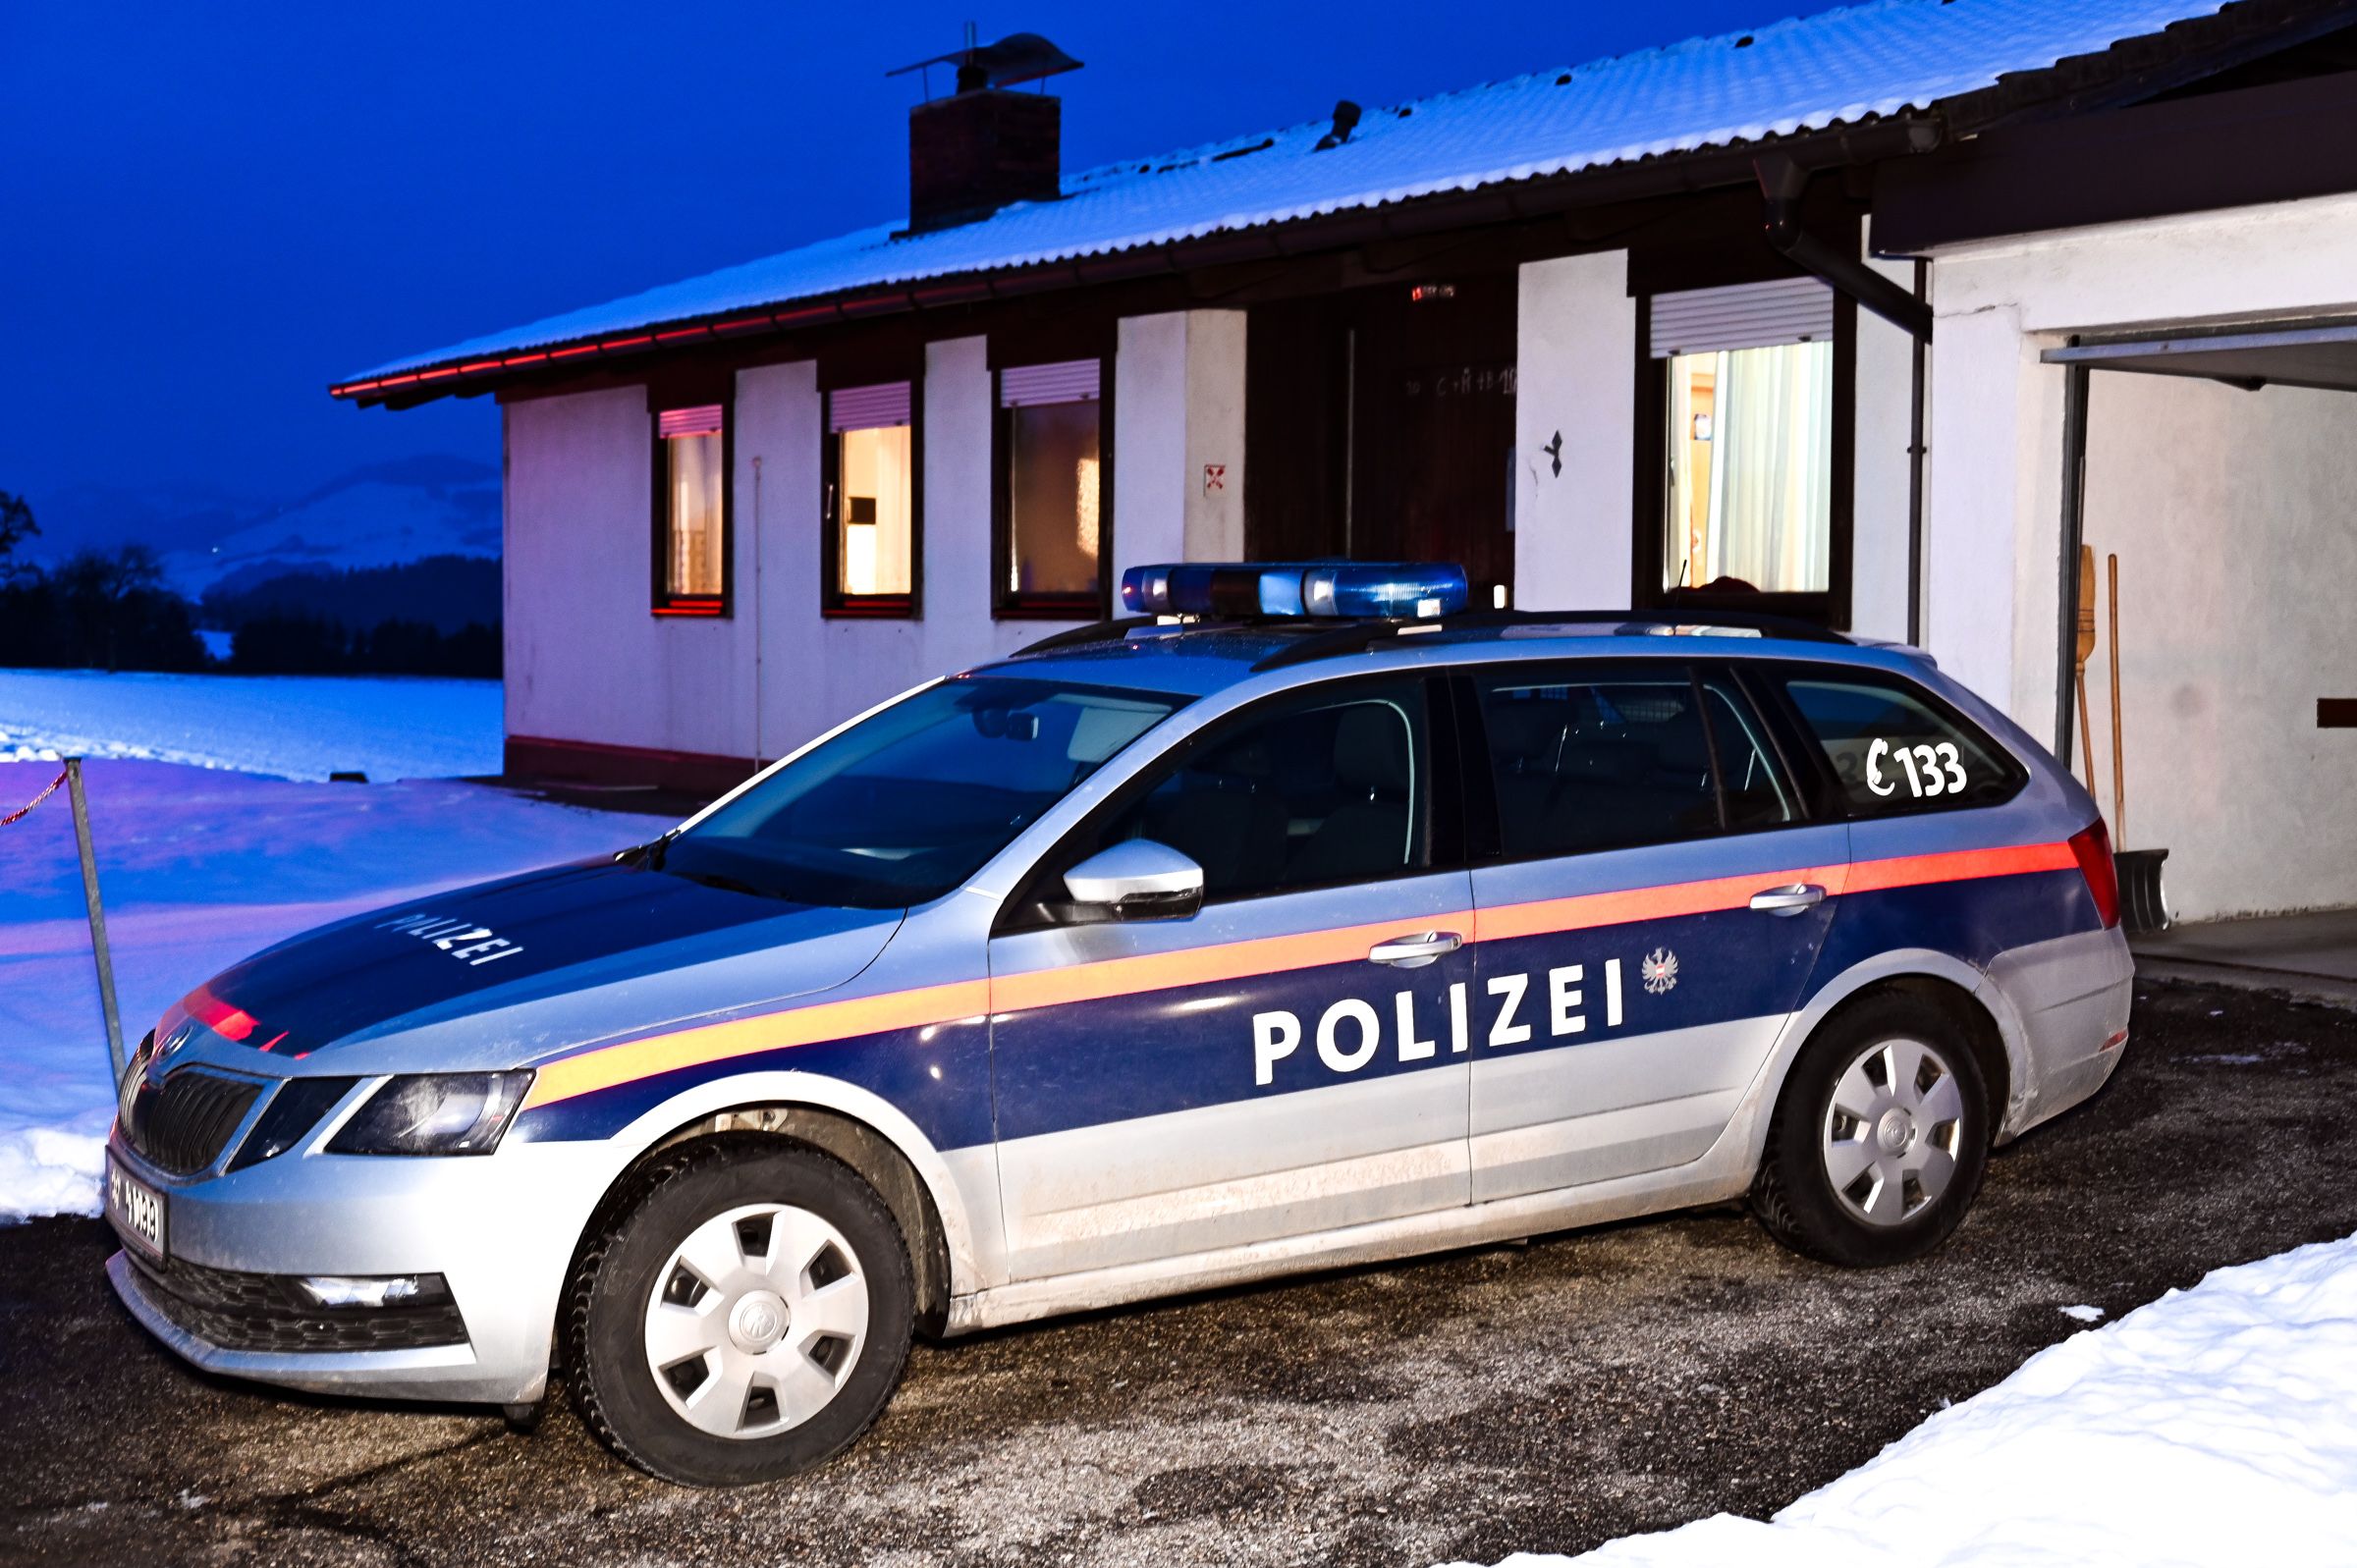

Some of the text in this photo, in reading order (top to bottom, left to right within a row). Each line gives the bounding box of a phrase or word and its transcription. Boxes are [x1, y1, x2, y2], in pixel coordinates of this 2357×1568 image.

[1893, 742, 1967, 798] 133
[374, 913, 524, 966] POLIZEI
[1252, 958, 1622, 1085] POLIZEI
